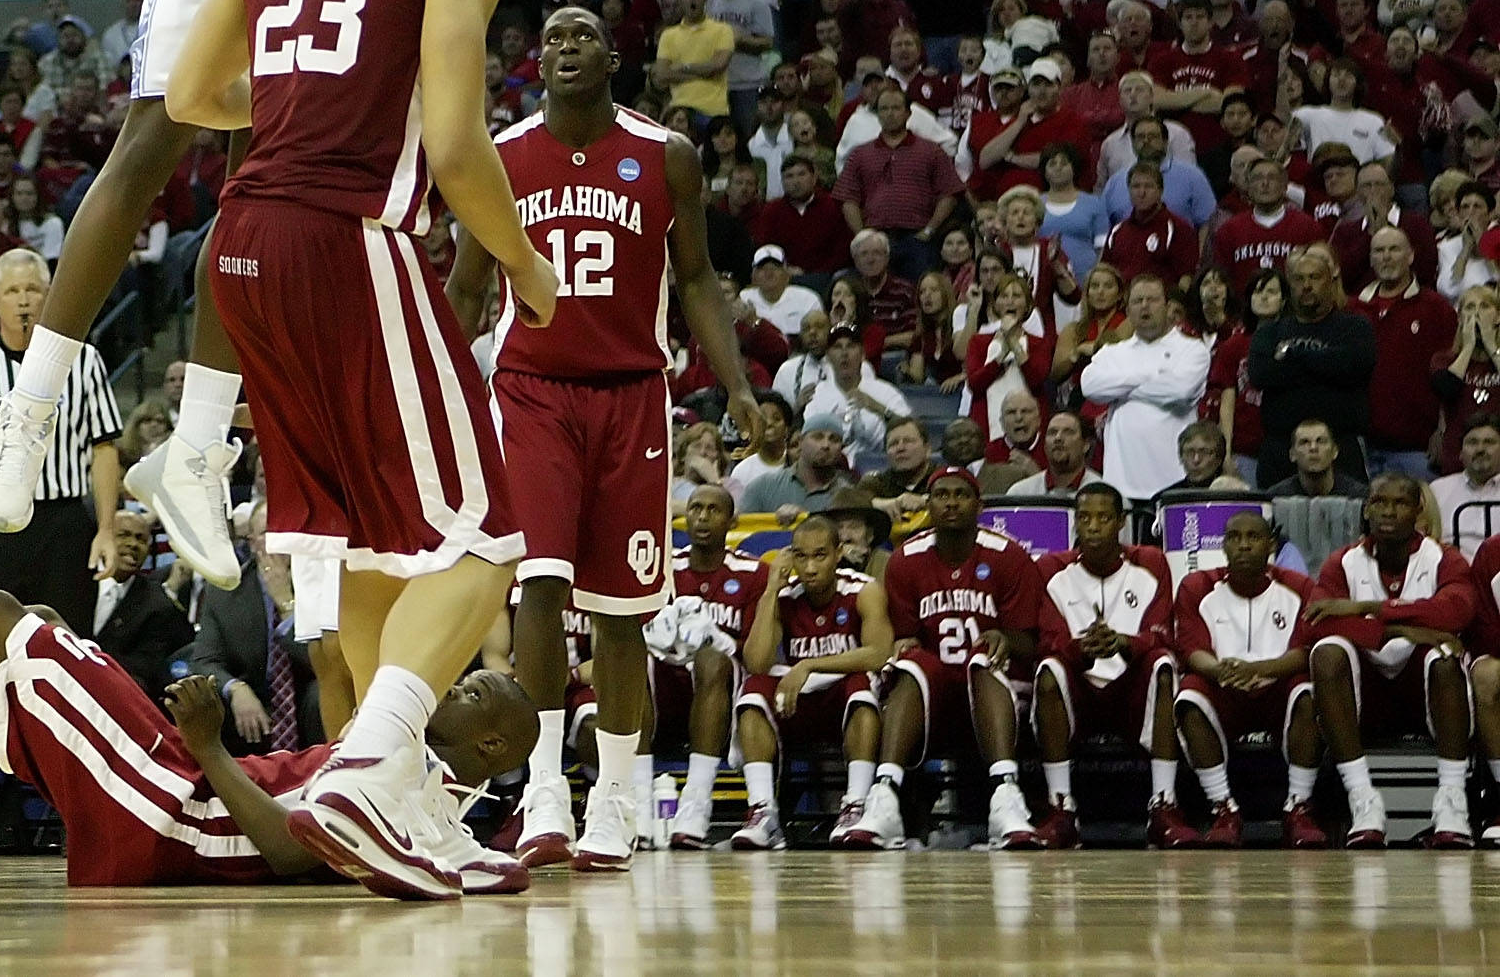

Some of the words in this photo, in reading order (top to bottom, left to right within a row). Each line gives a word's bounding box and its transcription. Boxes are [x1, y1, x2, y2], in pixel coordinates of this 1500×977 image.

[219, 255, 259, 278] SOONERS
[546, 228, 614, 296] 12
[627, 530, 660, 585] OU
[920, 589, 998, 619] OKLAHOMA
[939, 616, 980, 664] 21
